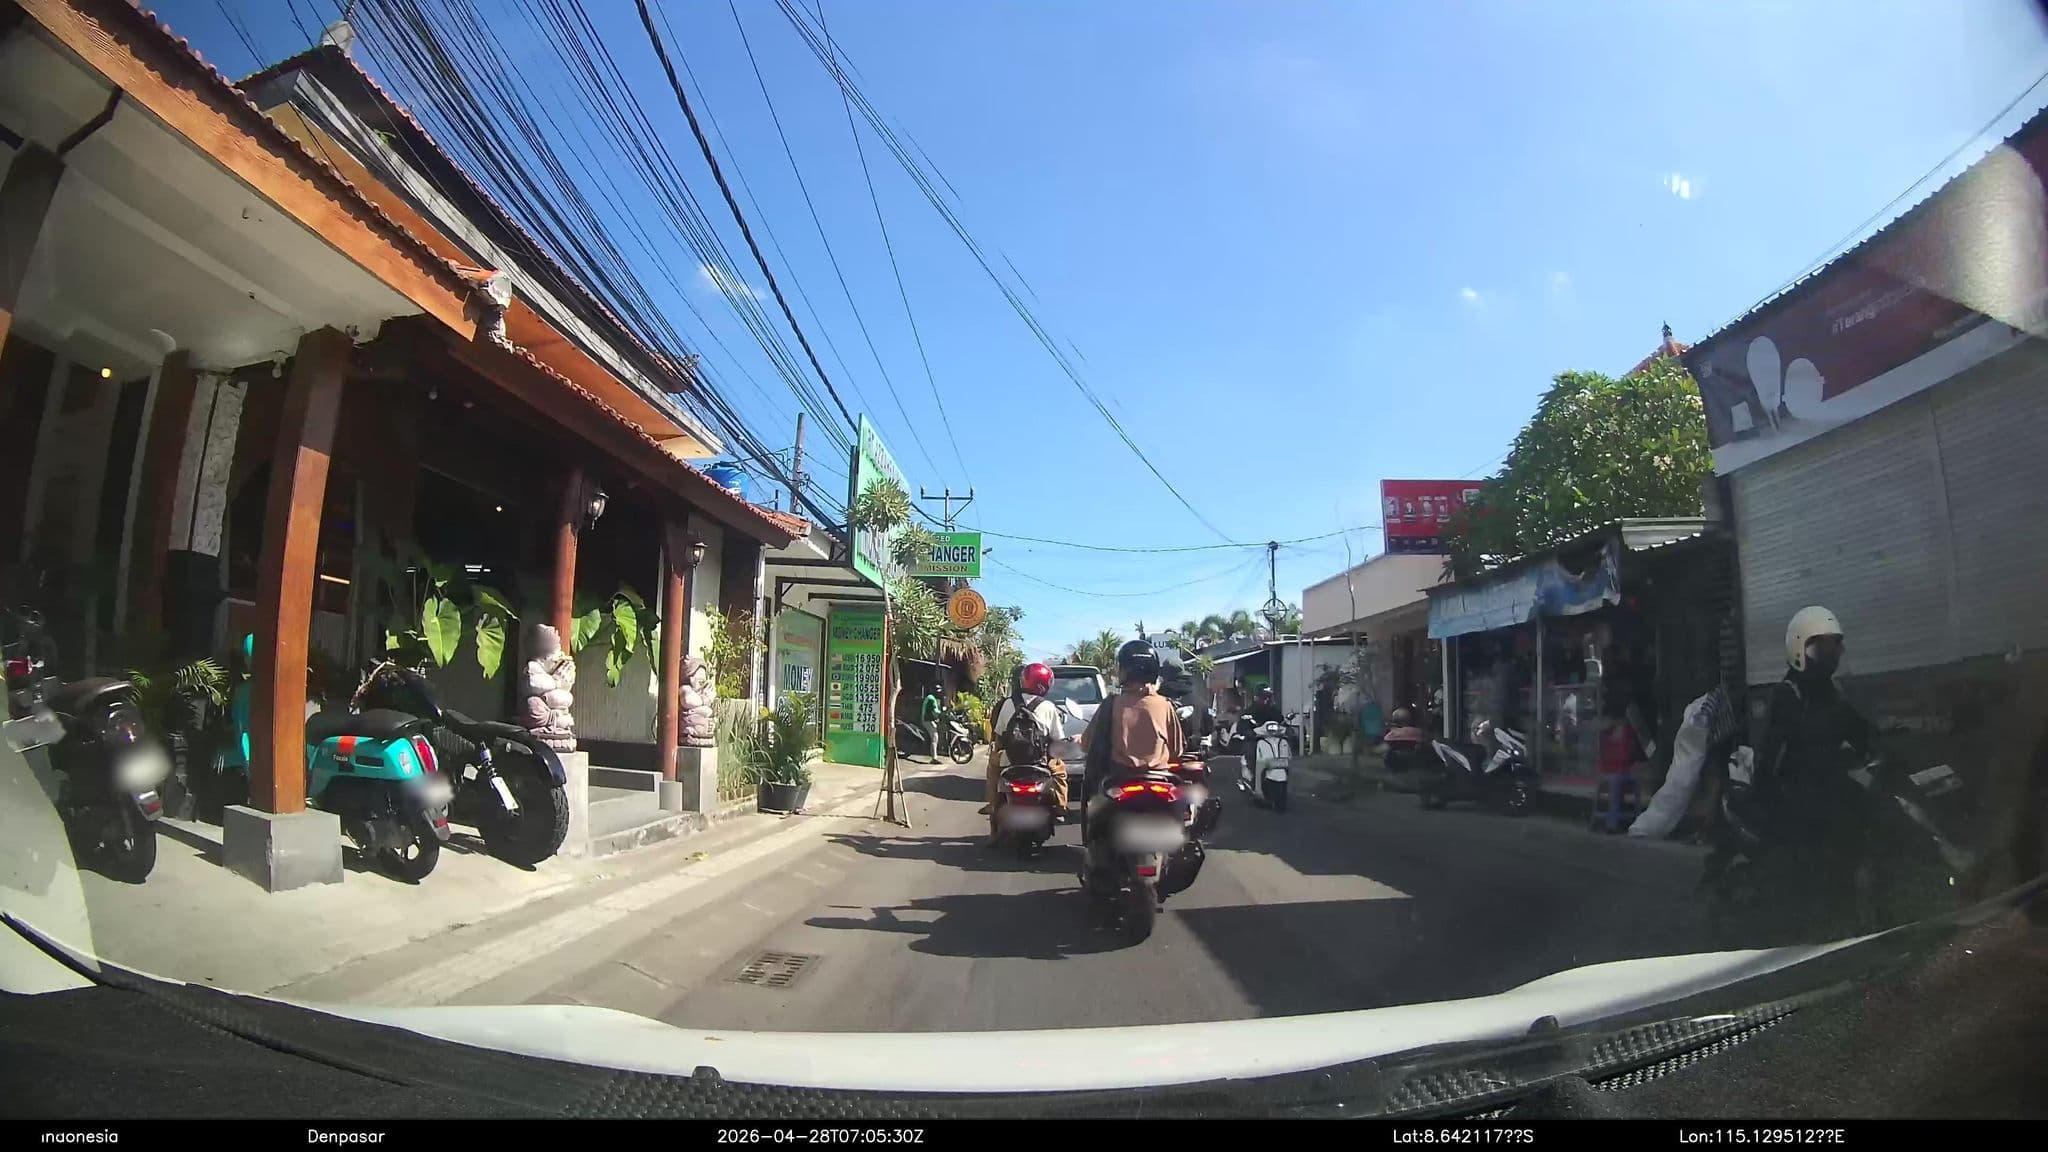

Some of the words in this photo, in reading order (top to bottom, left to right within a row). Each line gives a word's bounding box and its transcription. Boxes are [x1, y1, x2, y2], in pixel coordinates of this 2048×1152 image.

[927, 546, 976, 562] HANGER
[858, 703, 873, 713] 475
[862, 722, 876, 733] 120
